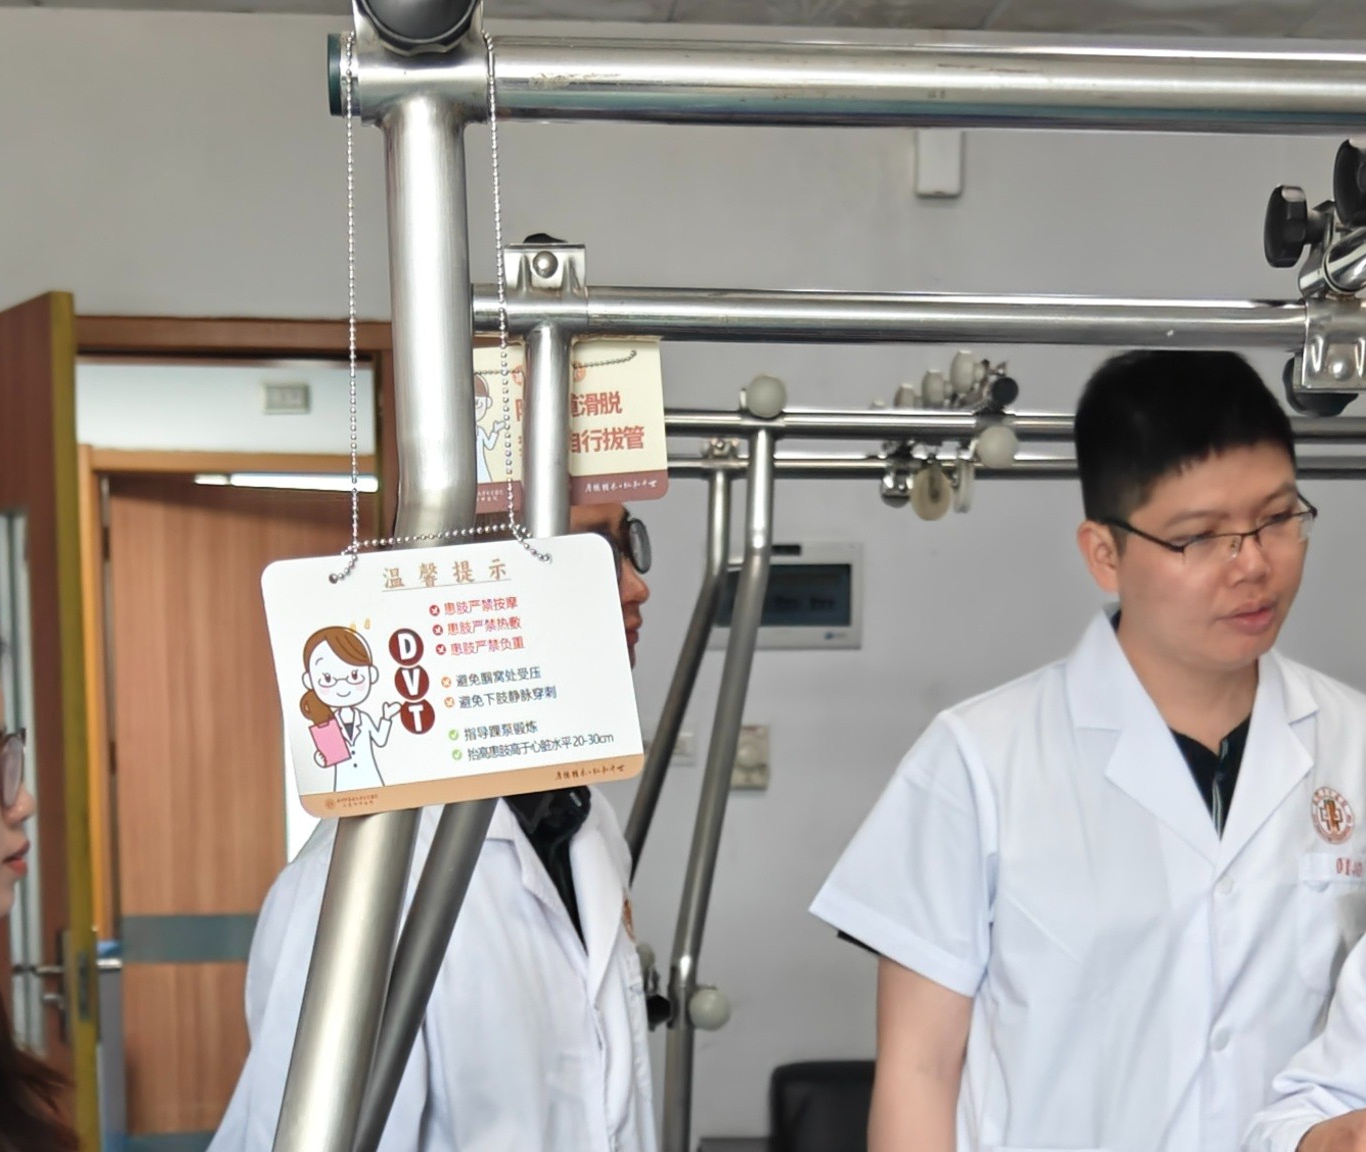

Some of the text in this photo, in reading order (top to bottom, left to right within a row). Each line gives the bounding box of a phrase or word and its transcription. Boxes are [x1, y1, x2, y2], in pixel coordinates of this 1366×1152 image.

[383, 558, 507, 588] 温馨提示
[444, 597, 519, 615] 患肢严禁按摩
[447, 616, 522, 635] 患肢严禁热敷
[450, 636, 525, 656] 患肢严禁负重
[459, 686, 557, 708] 避免下肢静脉穿刺
[464, 720, 539, 741] 指导踝泵锻炼
[467, 733, 615, 761] 抬高患肢高于心脏水平20-30cm
